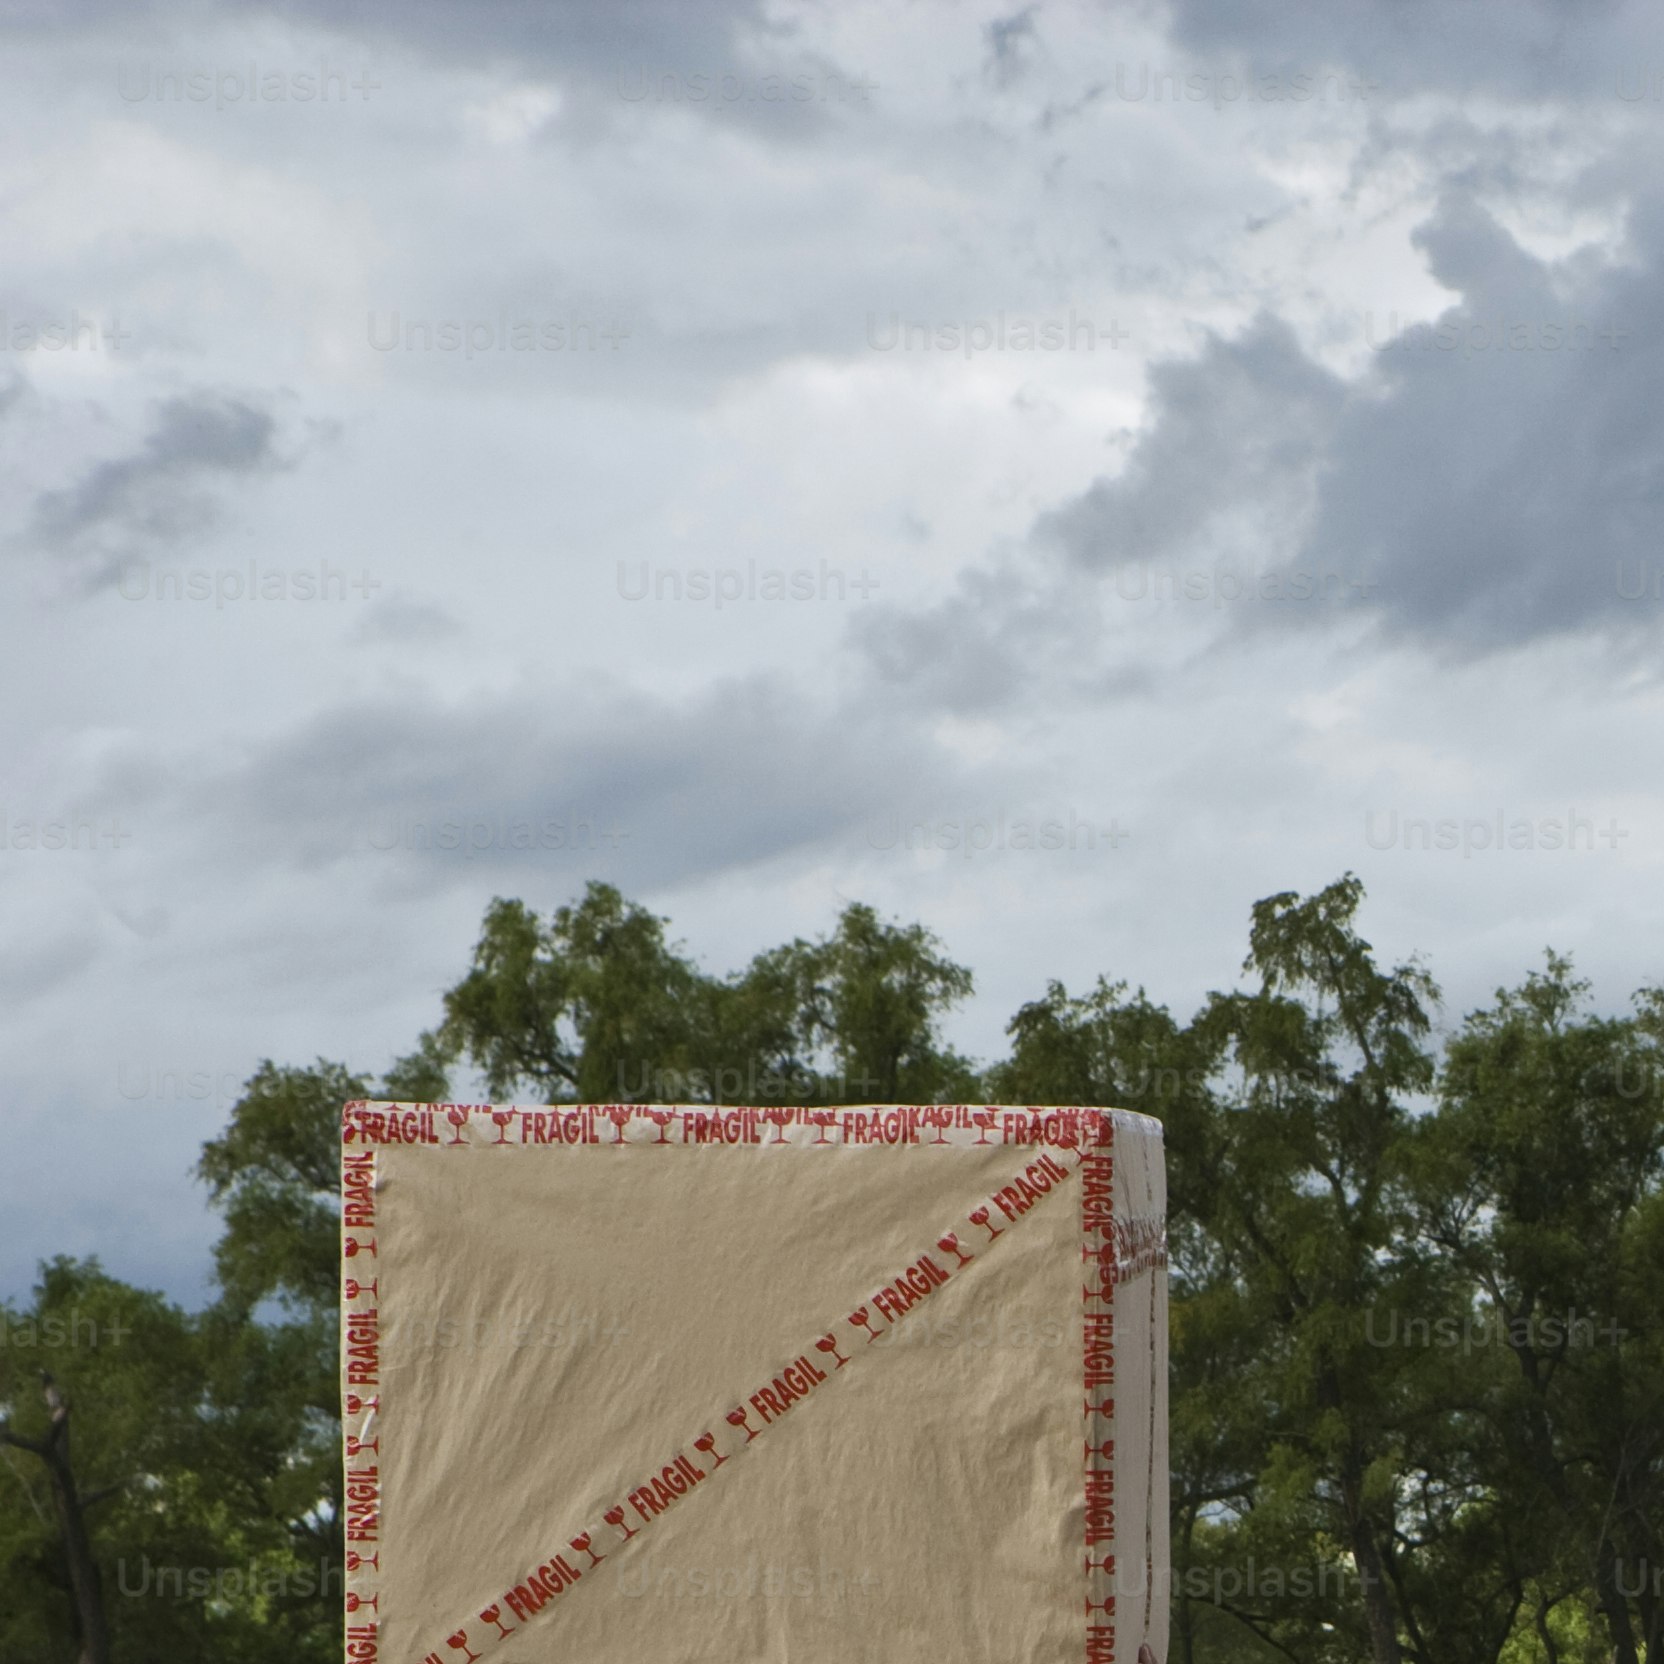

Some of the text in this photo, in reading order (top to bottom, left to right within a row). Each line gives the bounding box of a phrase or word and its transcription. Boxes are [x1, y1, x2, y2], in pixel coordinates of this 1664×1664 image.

[522, 1113, 599, 1144] FRAGIL
[683, 1113, 760, 1144] FRAGIL
[843, 1113, 921, 1144] FRAGIL
[344, 1150, 374, 1228] FRAGIL
[346, 1307, 380, 1386] FRAGIL
[1083, 1314, 1113, 1390] FRAGIL
[504, 1553, 581, 1622] FRAGIL
[627, 1455, 705, 1521] FRAGIL
[749, 1356, 827, 1421] FRAGIL
[872, 1255, 950, 1323] FRAGIL
[992, 1155, 1069, 1222] FRAGIL
[346, 1465, 379, 1542] FRAGIL
[1085, 1470, 1114, 1546] FRAGIL
